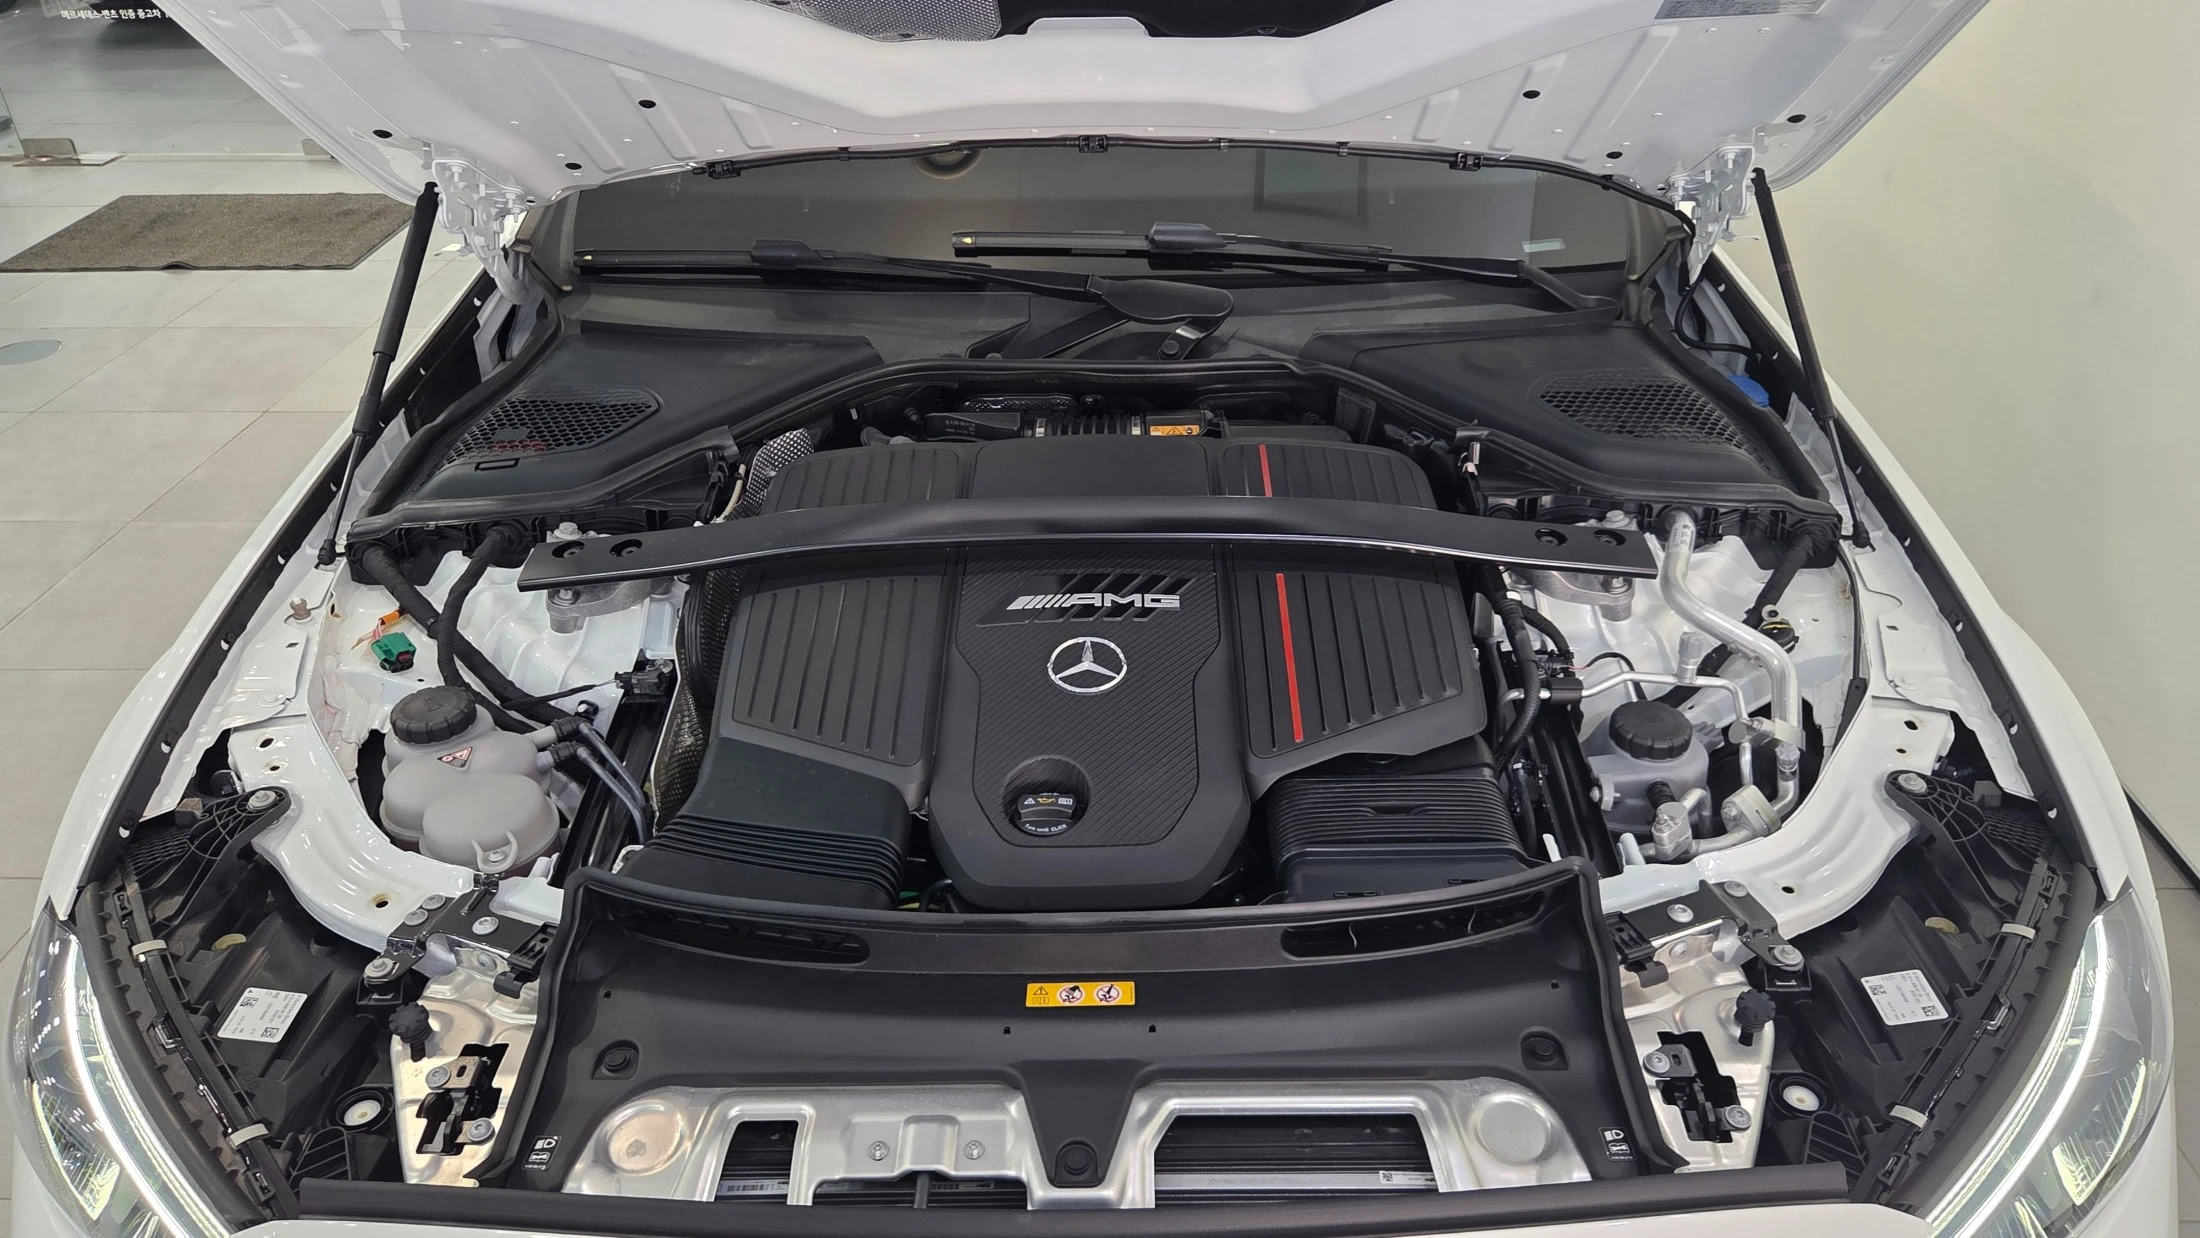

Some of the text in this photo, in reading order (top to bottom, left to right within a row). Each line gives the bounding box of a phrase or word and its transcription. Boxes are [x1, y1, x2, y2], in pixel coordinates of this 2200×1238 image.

[1061, 592, 1181, 610] AMG
[1024, 823, 1036, 832] Turn
[1050, 823, 1068, 832] CLICK
